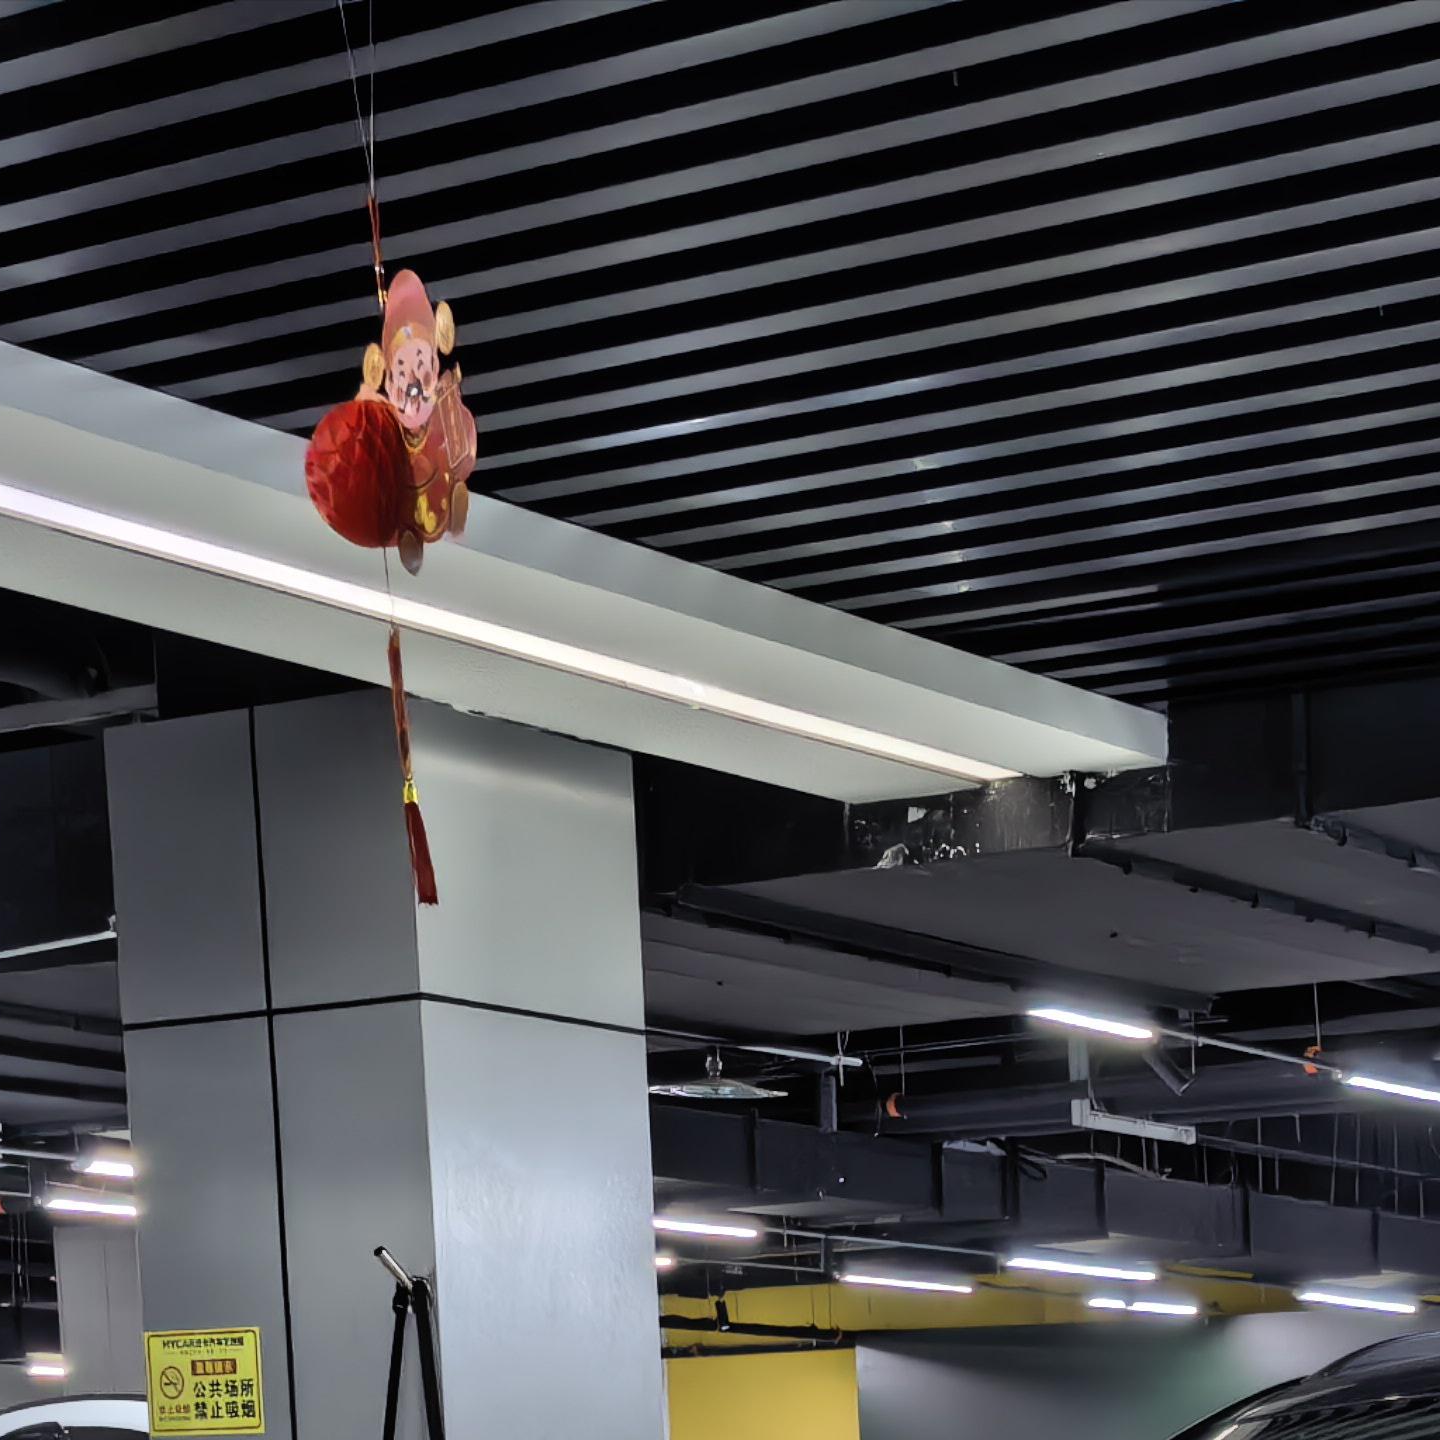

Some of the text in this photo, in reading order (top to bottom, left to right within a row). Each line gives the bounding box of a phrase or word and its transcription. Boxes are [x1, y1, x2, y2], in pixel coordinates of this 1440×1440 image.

[193, 1378, 254, 1399] 公共场所
[194, 1400, 256, 1420] 禁止吸烟
